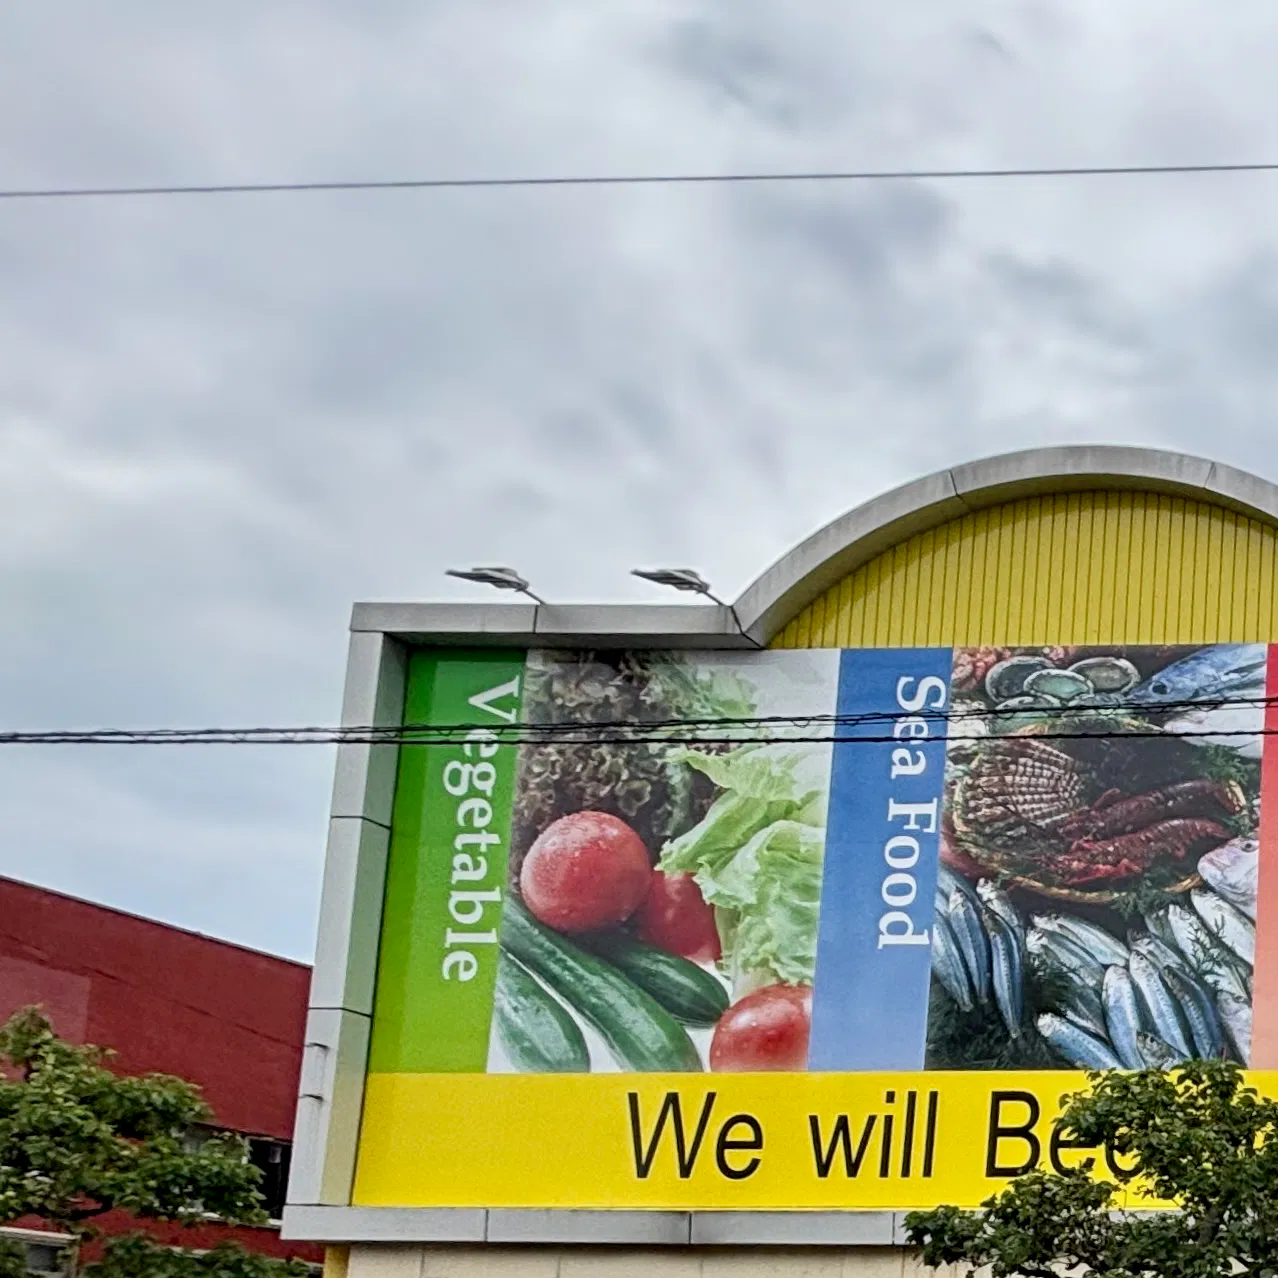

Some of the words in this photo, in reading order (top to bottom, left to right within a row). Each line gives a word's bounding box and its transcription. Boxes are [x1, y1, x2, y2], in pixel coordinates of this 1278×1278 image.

[890, 675, 947, 780] Sea
[441, 675, 521, 982] Vegetable
[877, 797, 939, 950] Food
[627, 1091, 764, 1180] We
[808, 1090, 939, 1179] will
